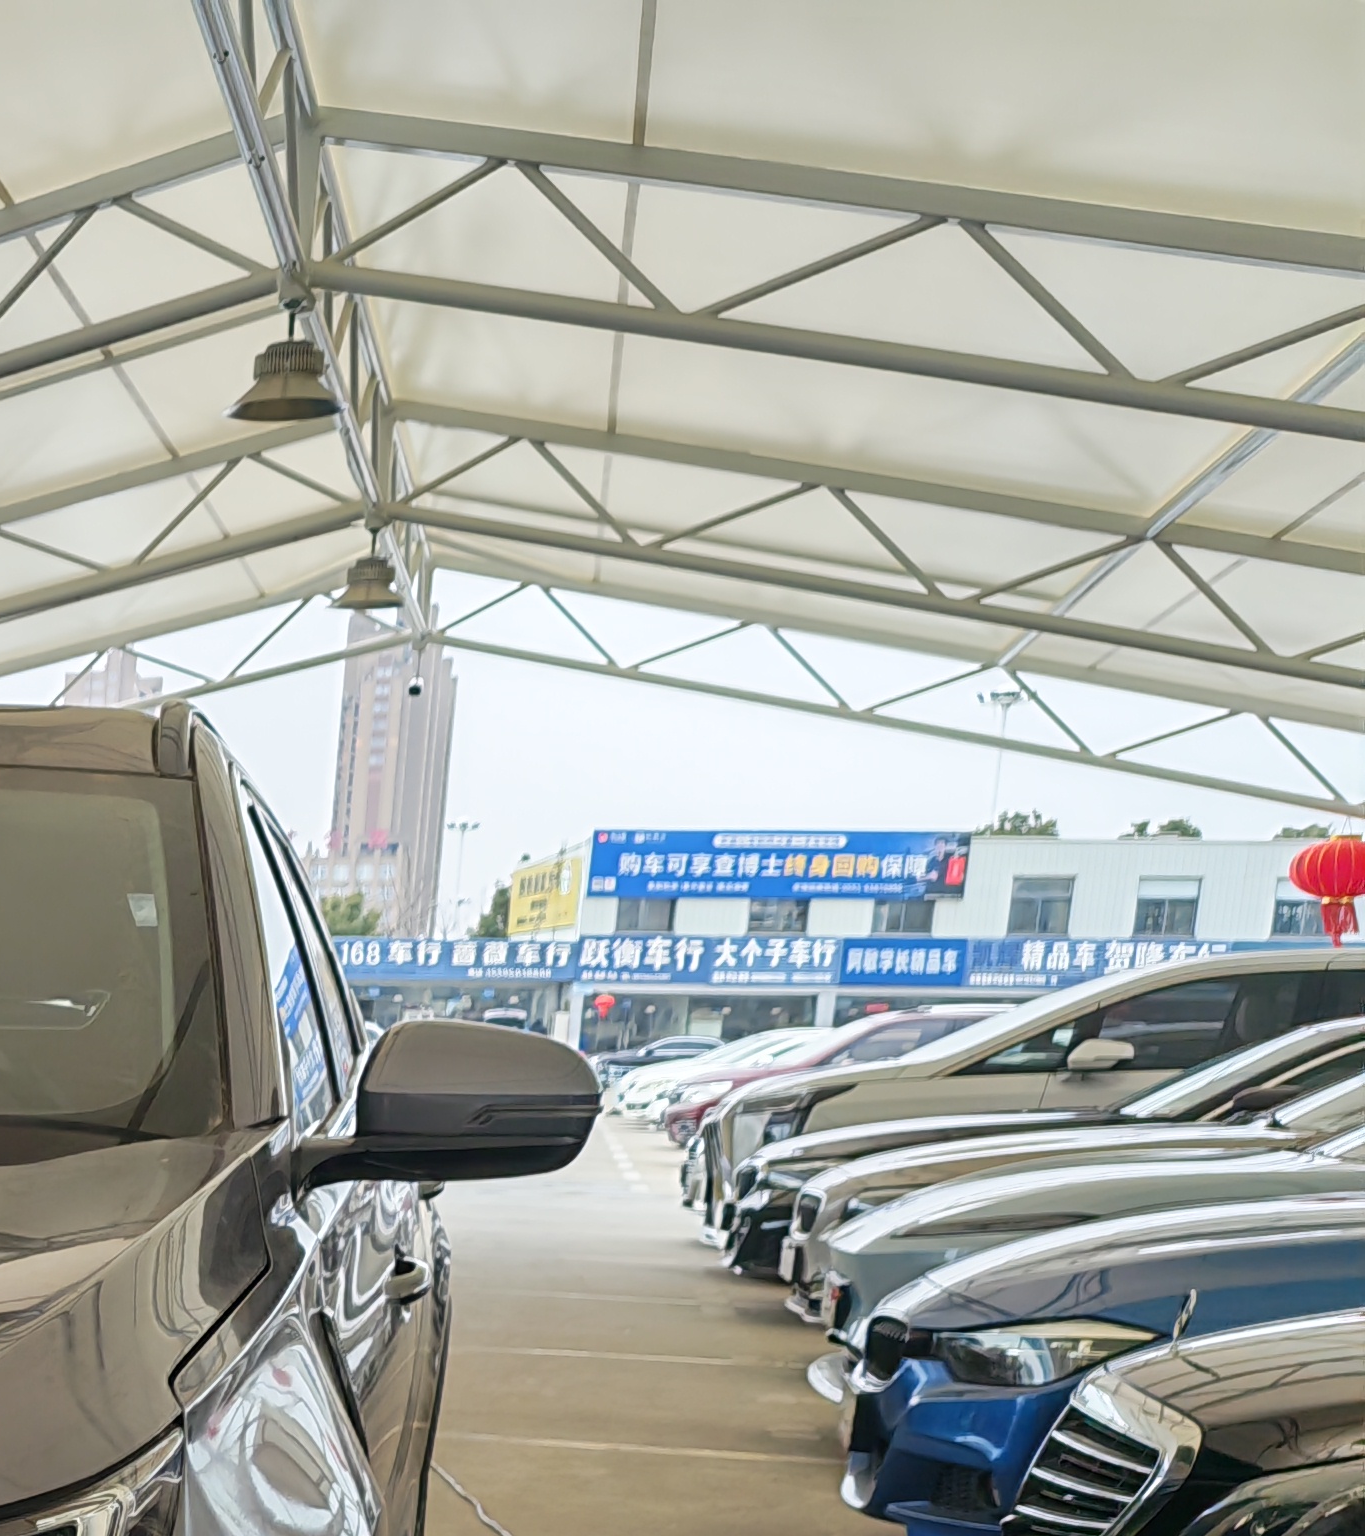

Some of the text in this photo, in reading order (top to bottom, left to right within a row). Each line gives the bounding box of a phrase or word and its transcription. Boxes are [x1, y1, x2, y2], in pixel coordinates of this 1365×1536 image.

[715, 937, 838, 968] 大个子车行
